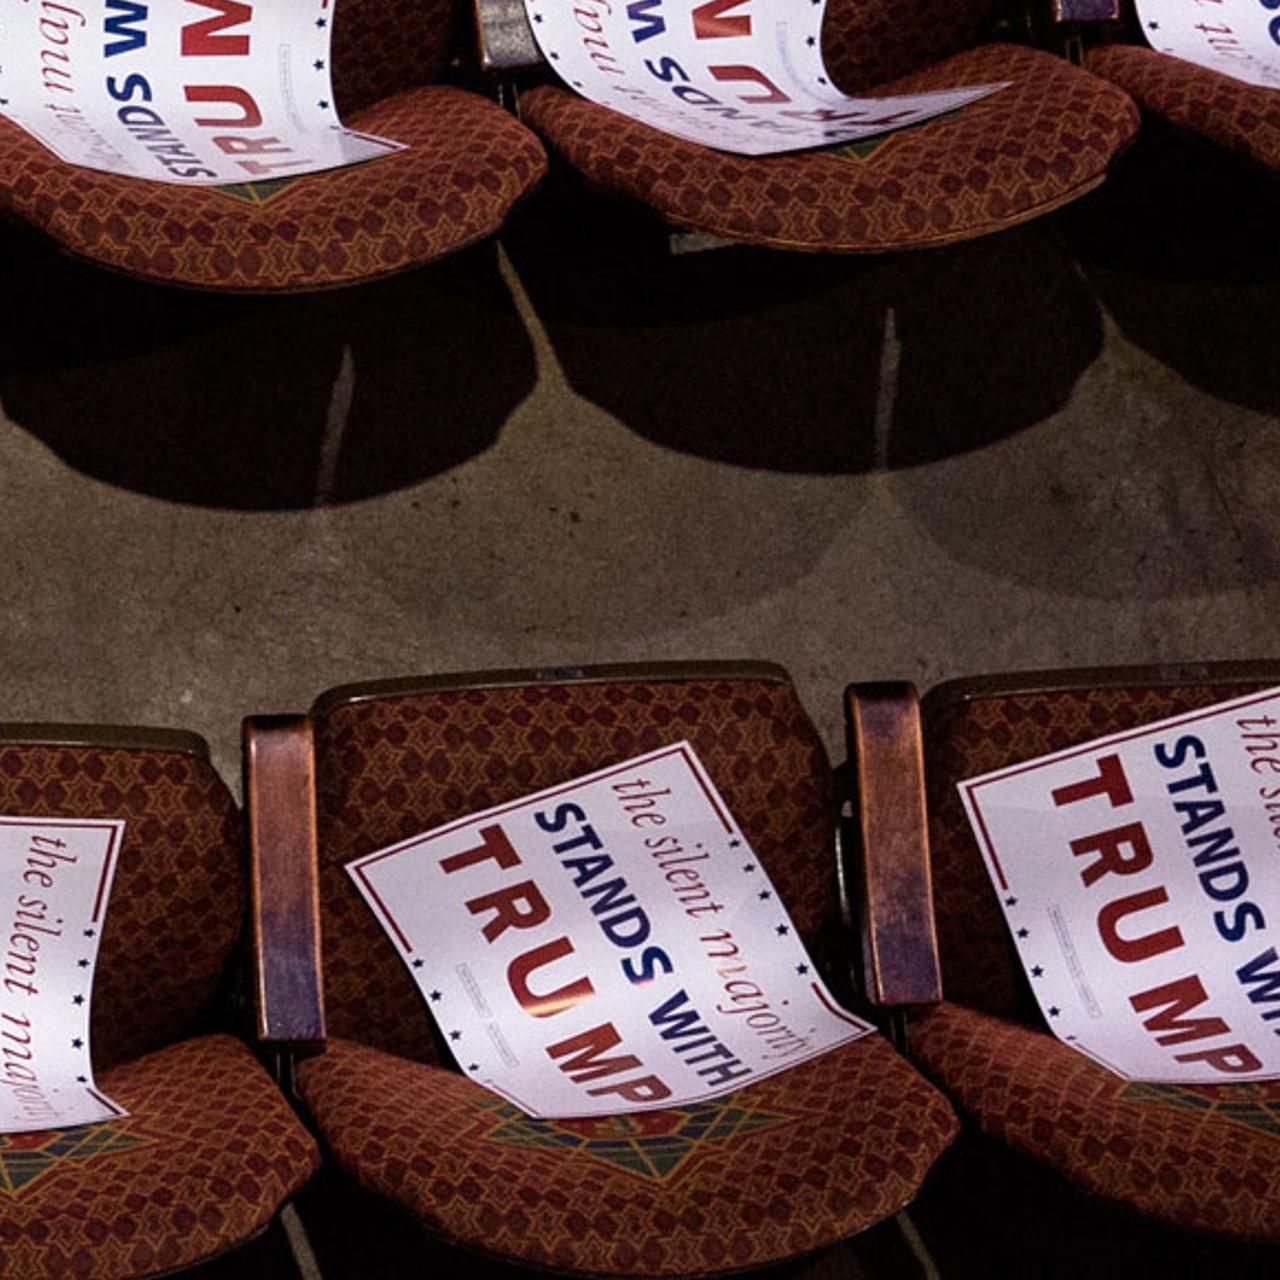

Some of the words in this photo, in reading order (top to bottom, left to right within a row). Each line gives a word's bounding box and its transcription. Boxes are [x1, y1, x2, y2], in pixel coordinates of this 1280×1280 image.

[106, 72, 218, 179] STANDS
[23, 834, 77, 887] the
[611, 777, 670, 828] the
[645, 835, 724, 919] silent
[1050, 753, 1263, 1075] TRUMP
[1154, 734, 1266, 943] STANDS
[4, 896, 63, 997] silent
[438, 823, 673, 1103] TRUMP
[535, 801, 673, 988] STANDS
[648, 989, 753, 1087] WITH
